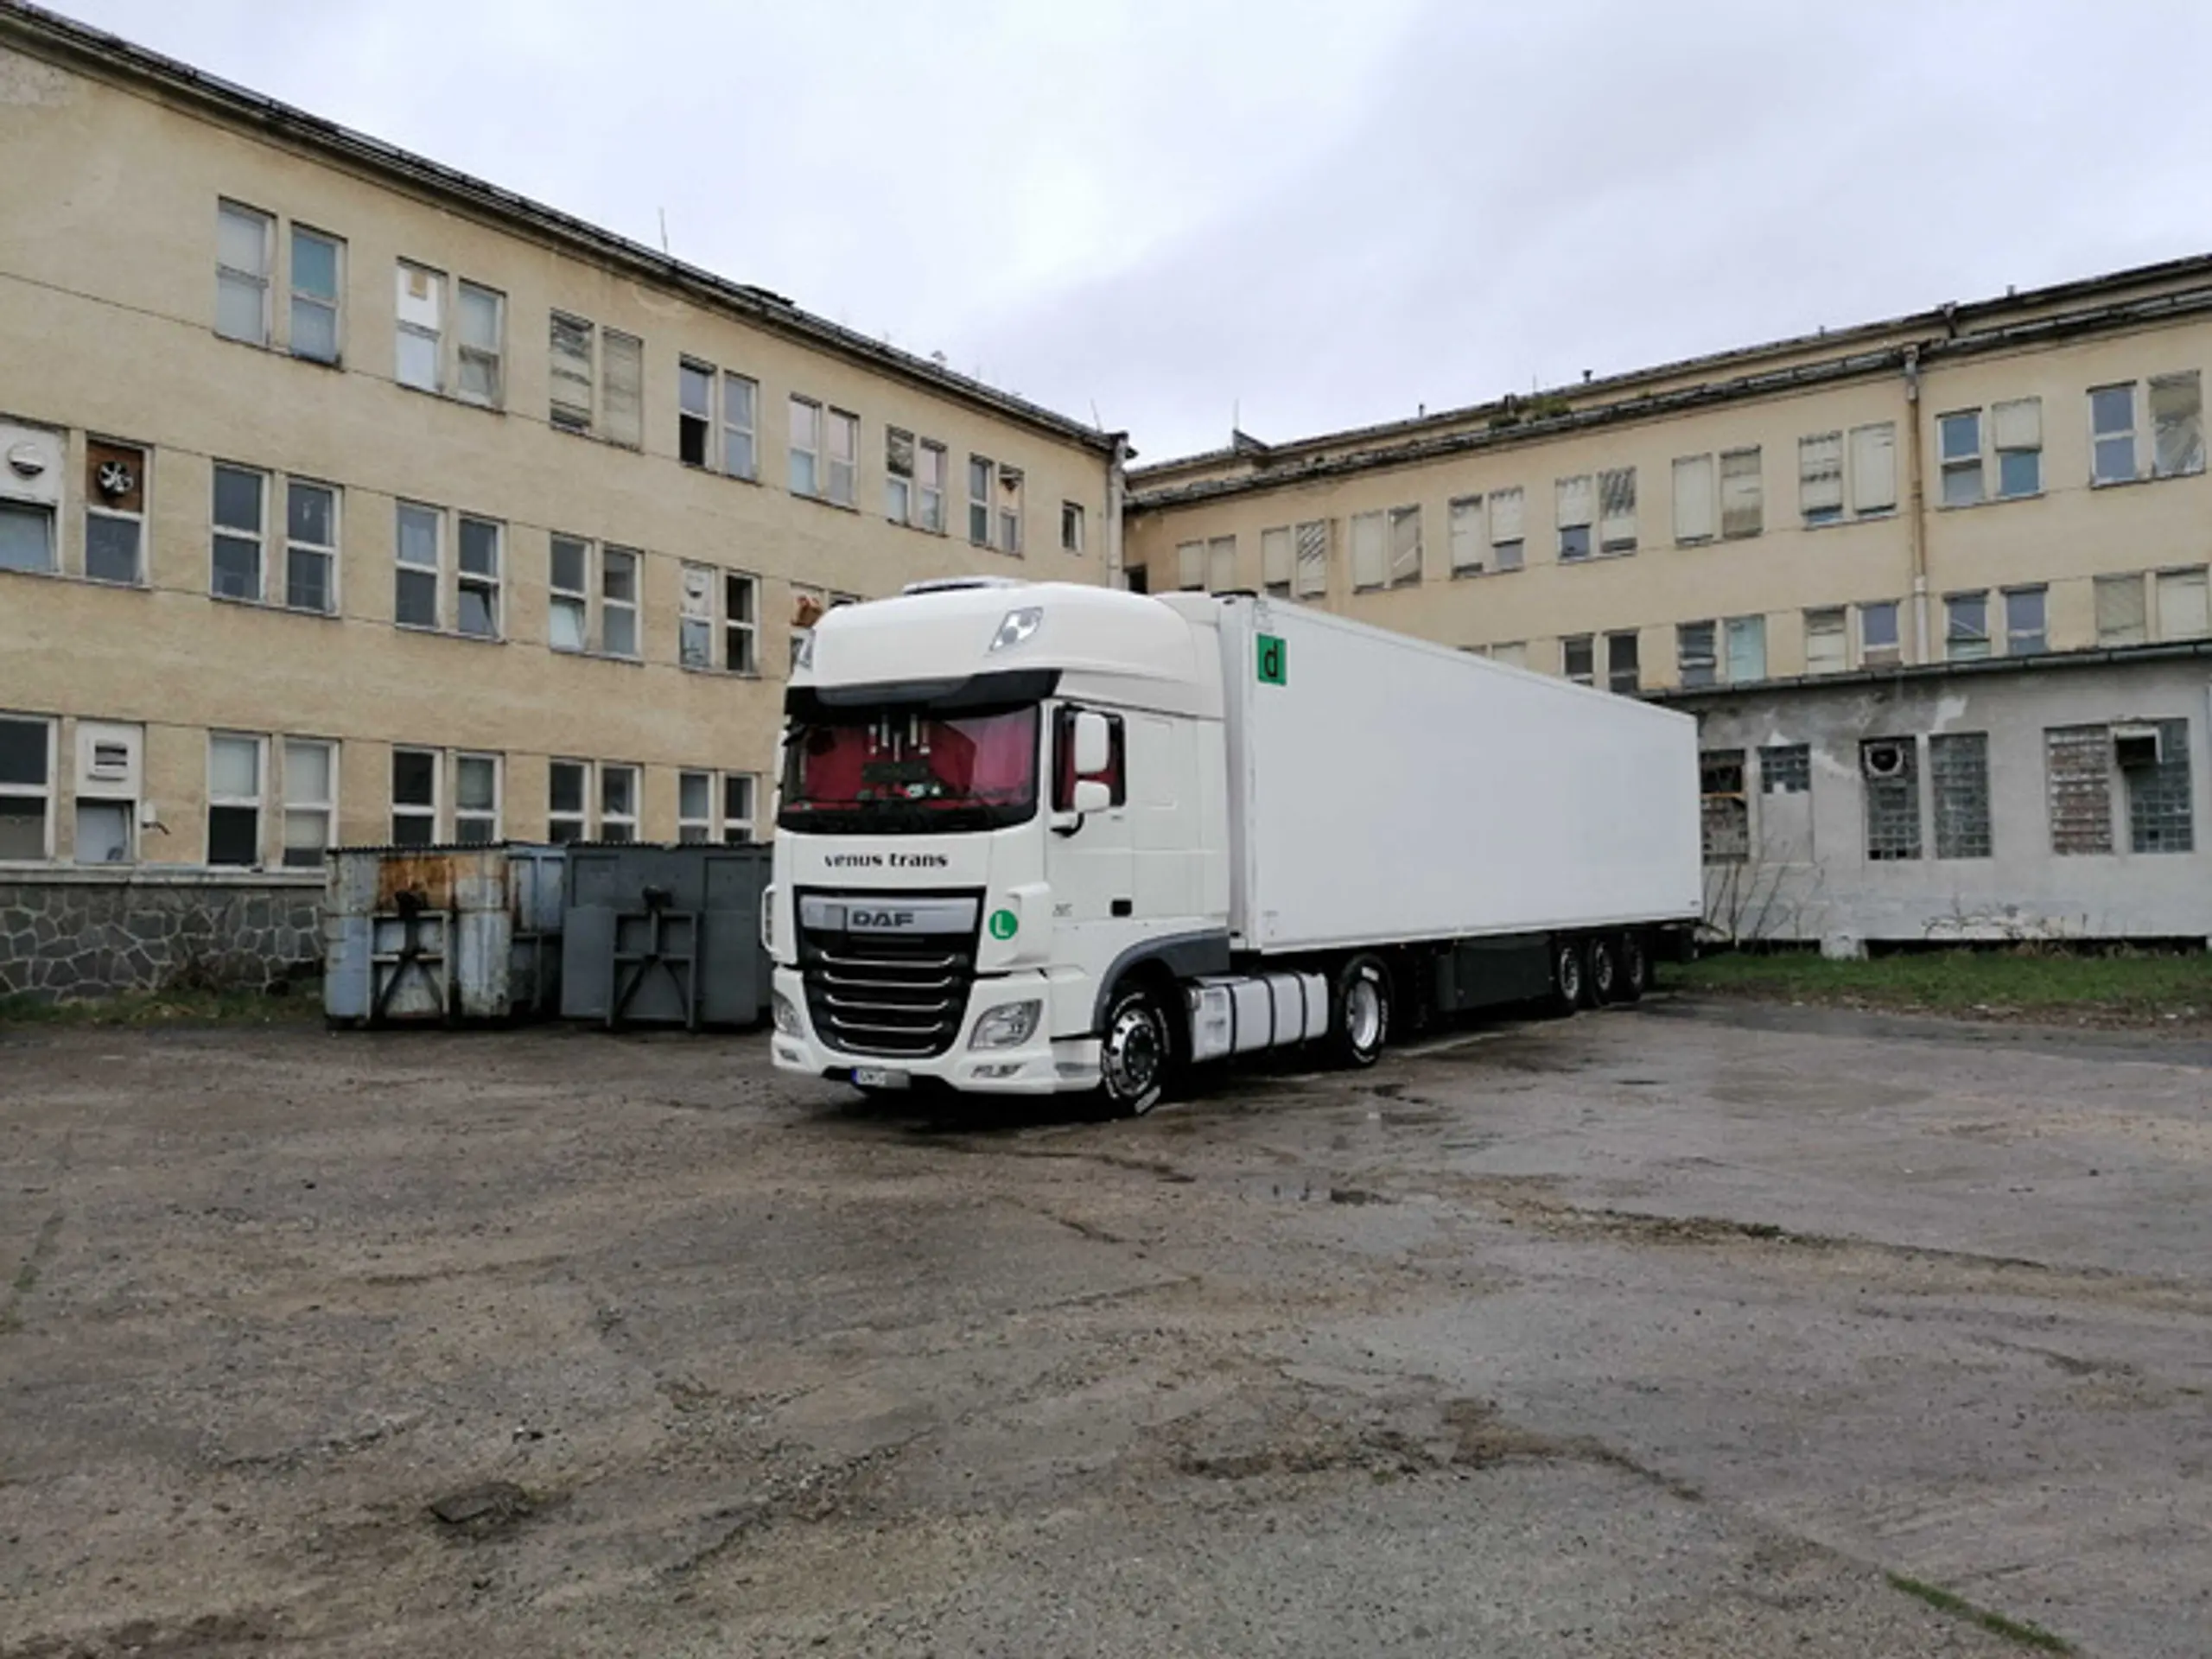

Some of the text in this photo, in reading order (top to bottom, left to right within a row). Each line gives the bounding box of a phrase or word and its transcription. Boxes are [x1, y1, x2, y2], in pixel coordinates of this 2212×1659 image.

[1264, 639, 1278, 678] d
[824, 853, 949, 868] venus trans
[851, 912, 915, 927] DAF
[995, 912, 1010, 937] L
